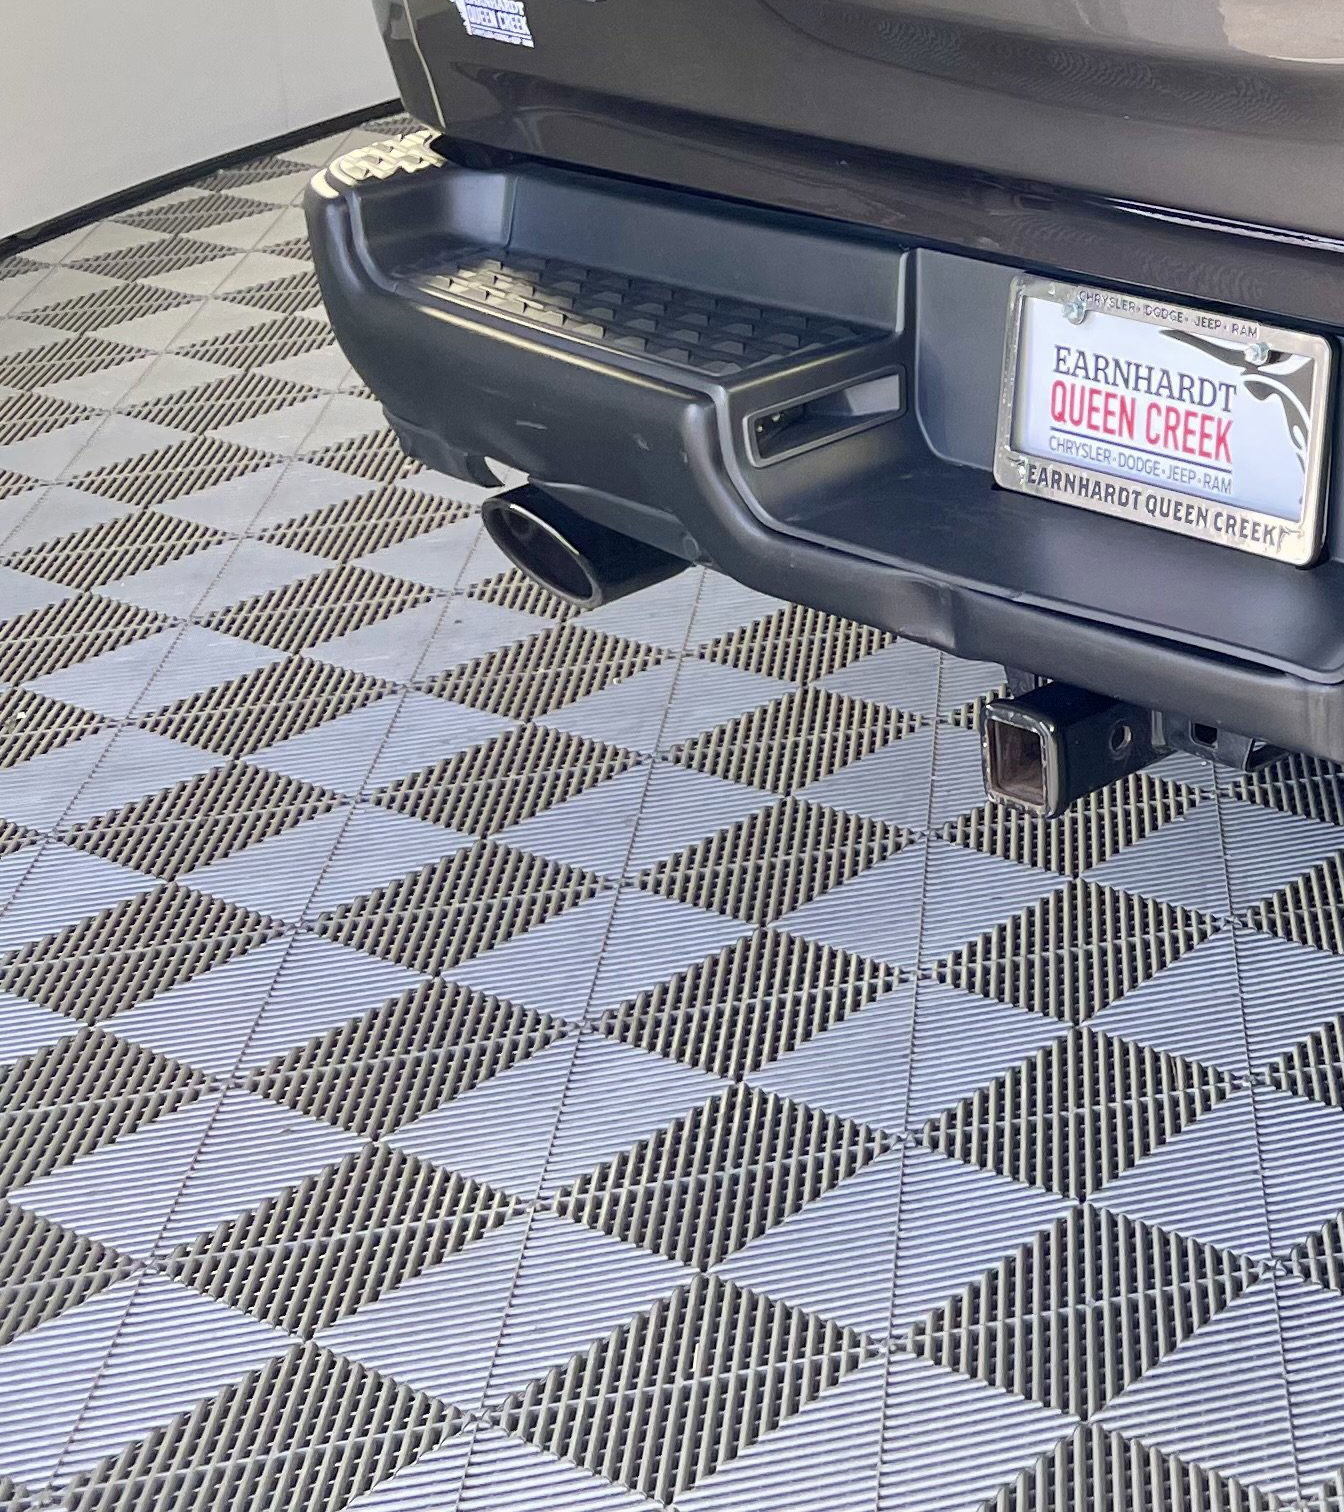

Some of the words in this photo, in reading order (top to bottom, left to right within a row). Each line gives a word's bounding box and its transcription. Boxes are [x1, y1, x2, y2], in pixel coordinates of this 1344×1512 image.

[1079, 290, 1136, 312] CHRYSLER
[1144, 304, 1184, 325] DODGE
[1194, 316, 1223, 331] JEEP
[1231, 323, 1258, 339] RAM
[1053, 344, 1237, 413] EARNHARDT
[1050, 379, 1136, 441] QUEEN
[1145, 401, 1234, 465] CREEK
[1049, 435, 1112, 464] CHRYSLER
[1117, 452, 1162, 477] DODGE
[1166, 464, 1197, 485] JEEP
[1202, 473, 1233, 495] RAM
[1026, 464, 1142, 512] EARNHARDT
[1145, 493, 1210, 529] QUEEN
[1213, 511, 1280, 545] CREEK
